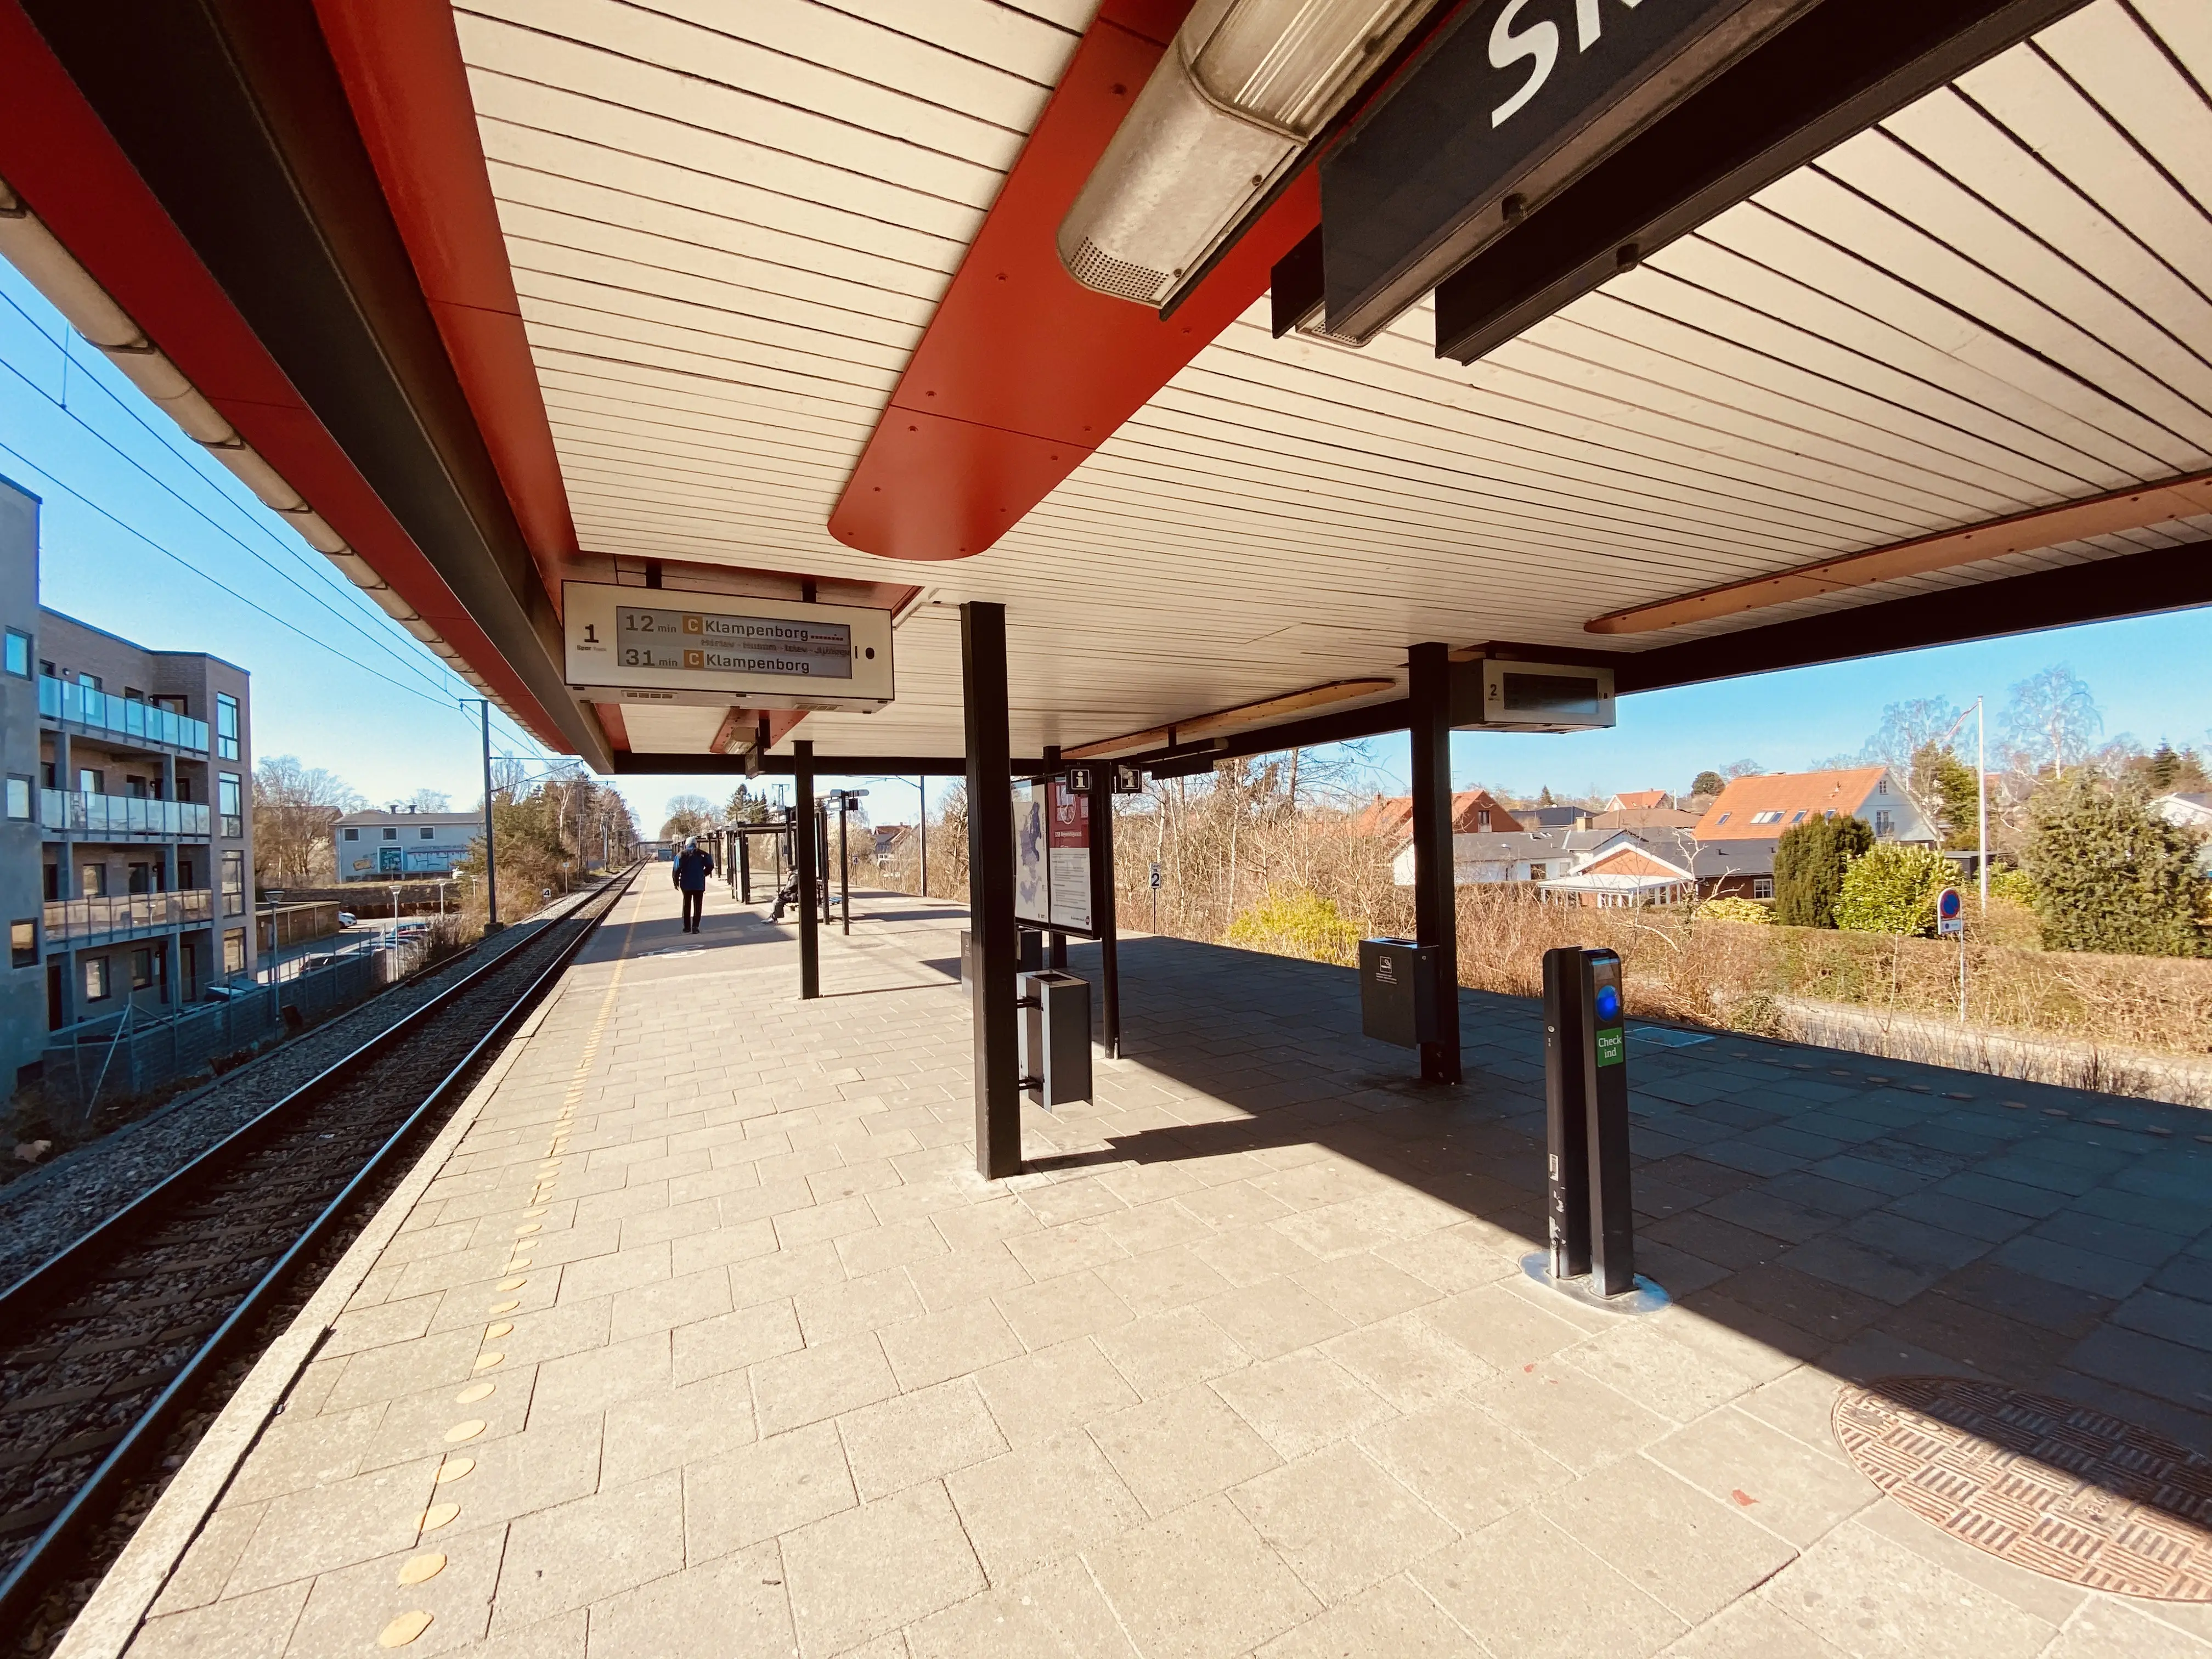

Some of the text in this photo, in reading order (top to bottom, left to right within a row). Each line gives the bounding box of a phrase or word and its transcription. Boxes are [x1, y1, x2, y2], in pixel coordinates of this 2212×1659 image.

[1488, 0, 1644, 129] S
[584, 624, 599, 643] 1
[625, 614, 808, 641] 12 min C Klampenborg
[626, 649, 809, 674] 31 min C Klampenborg
[1490, 684, 1497, 696] 2
[1152, 873, 1160, 887] 2
[1598, 1035, 1622, 1048] Check
[1604, 1047, 1617, 1058] ind
